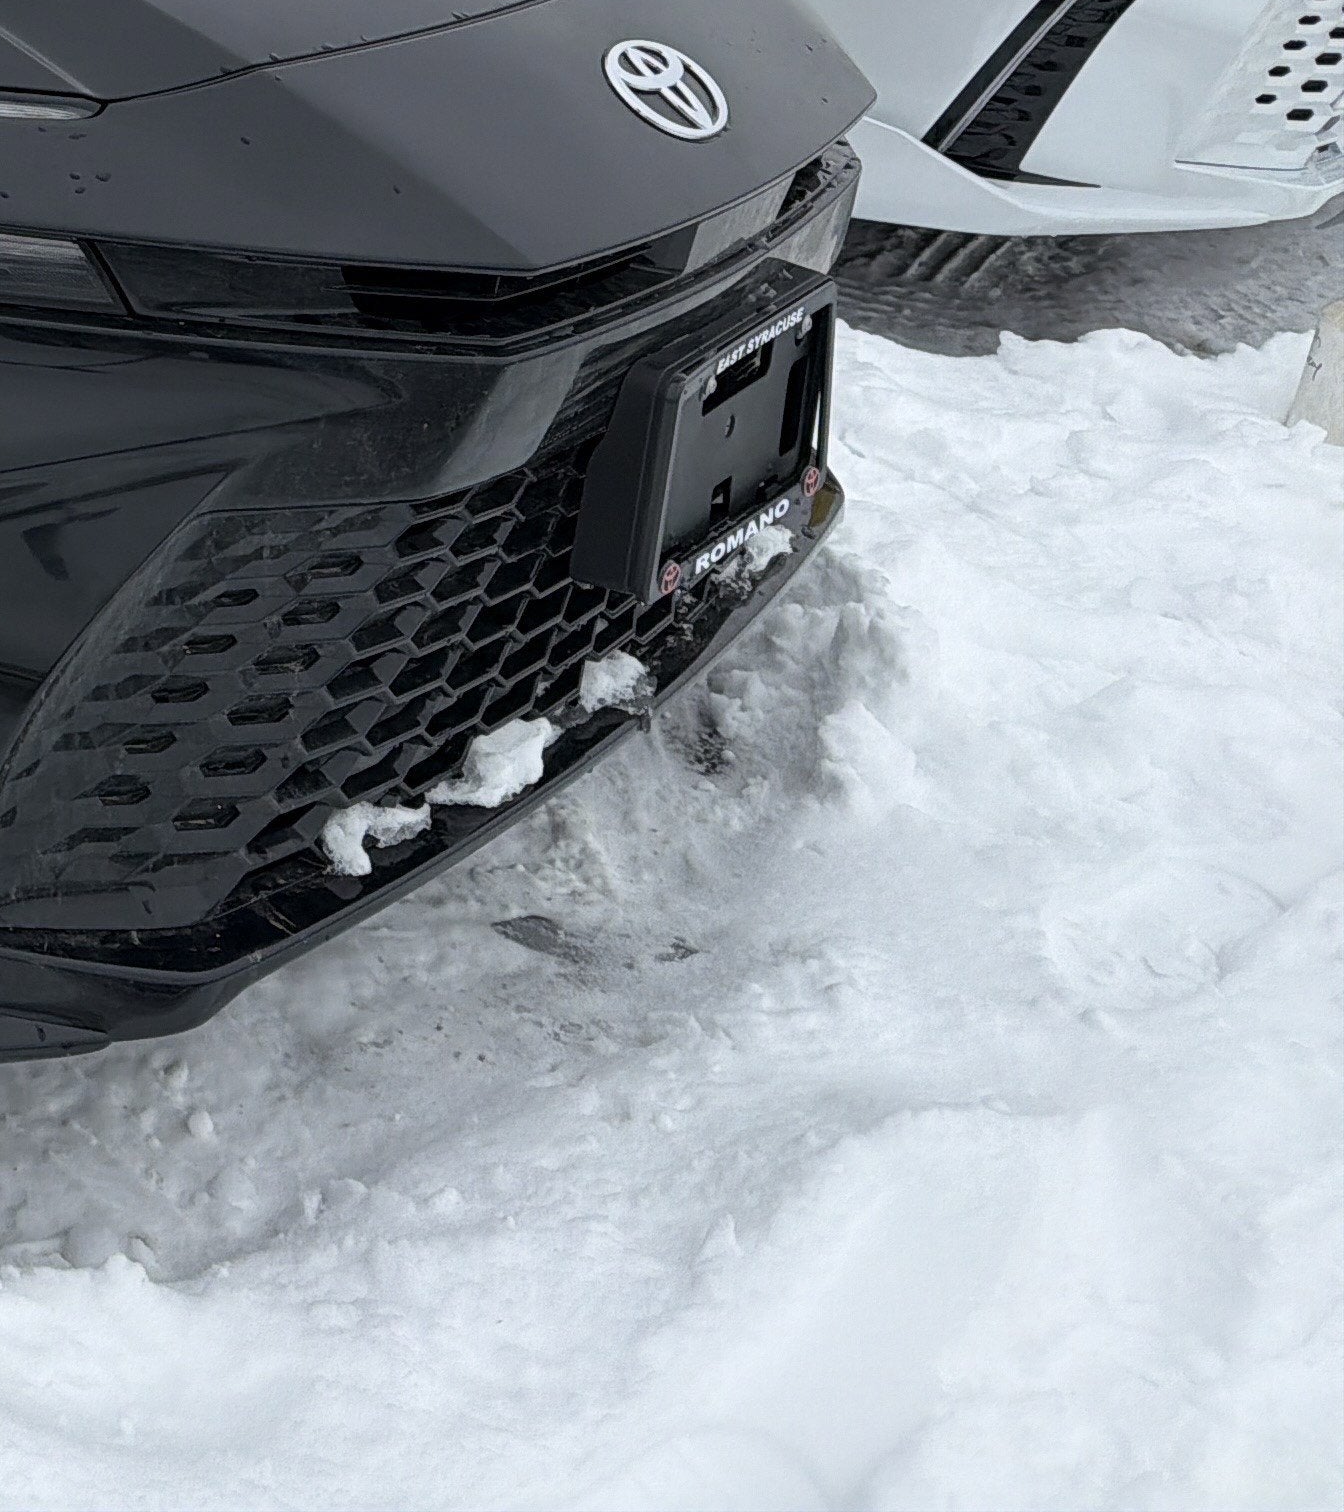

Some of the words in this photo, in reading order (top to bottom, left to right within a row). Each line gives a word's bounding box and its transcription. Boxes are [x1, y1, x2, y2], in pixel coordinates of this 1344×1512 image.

[716, 345, 746, 375] EAST
[746, 306, 805, 354] SYRACUSE
[695, 498, 790, 575] ROMANO
